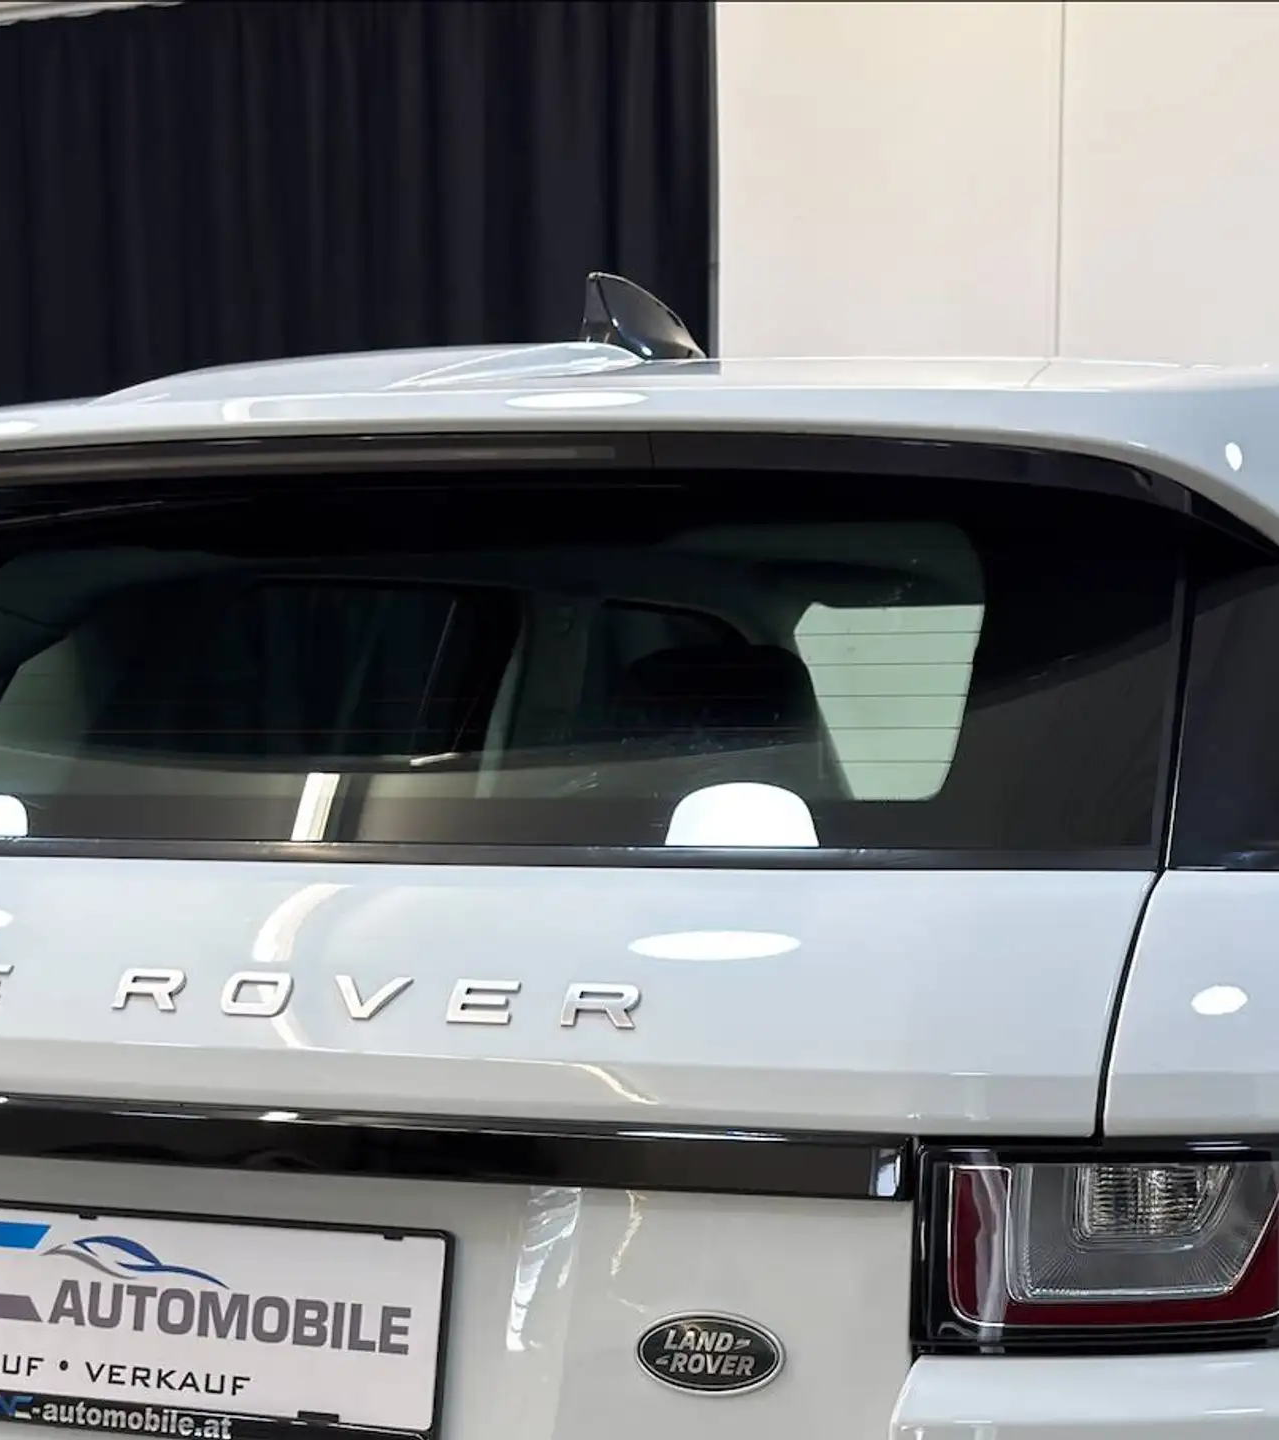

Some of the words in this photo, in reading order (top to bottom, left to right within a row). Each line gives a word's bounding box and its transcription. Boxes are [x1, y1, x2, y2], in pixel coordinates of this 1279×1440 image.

[112, 968, 649, 1031] ROVER
[48, 1279, 413, 1356] AUTOMOBILE
[663, 1329, 735, 1353] LAND
[84, 1360, 253, 1397] VERKAUF
[670, 1352, 756, 1376] ROVER
